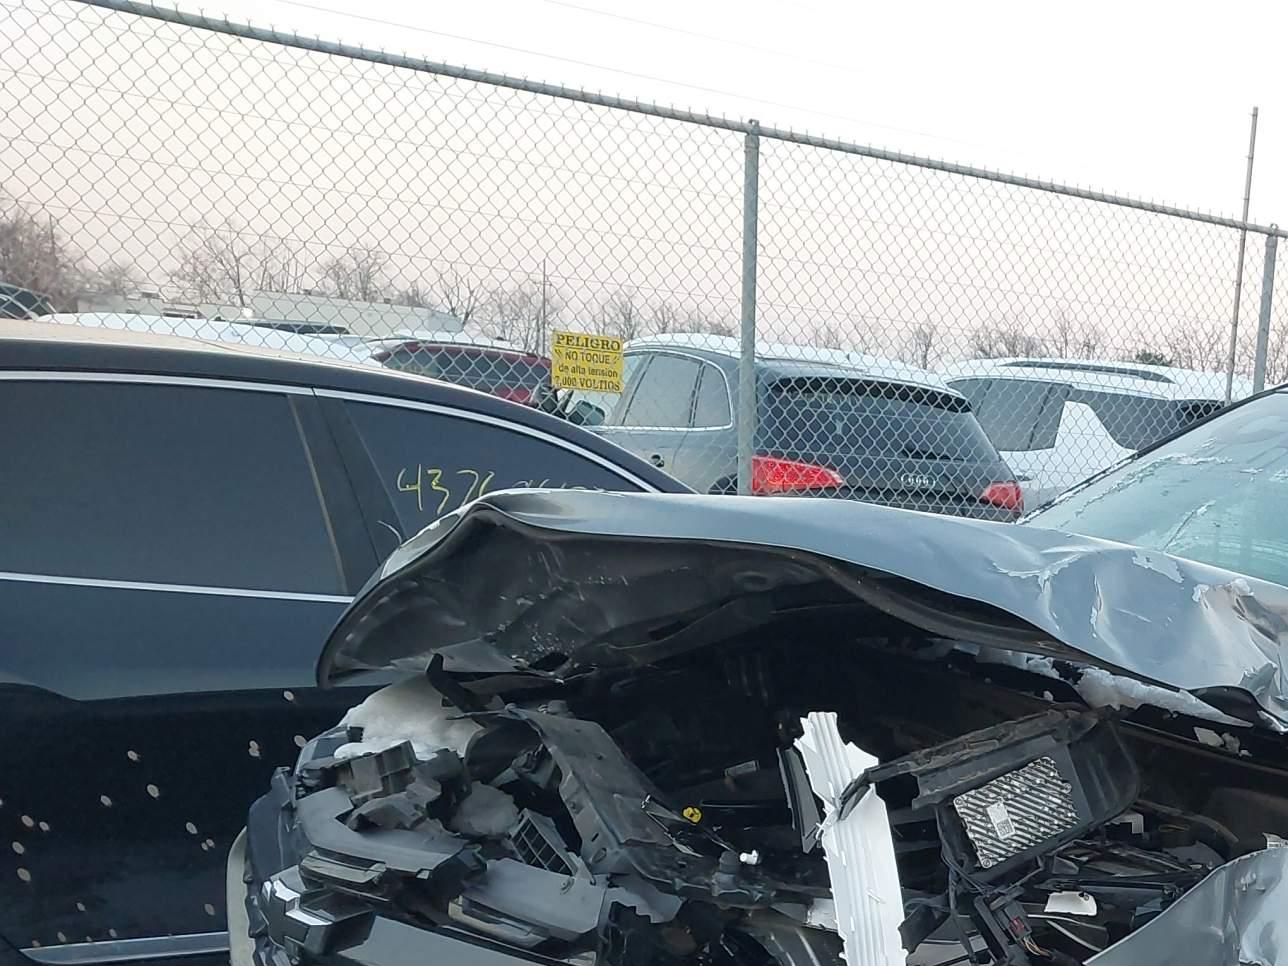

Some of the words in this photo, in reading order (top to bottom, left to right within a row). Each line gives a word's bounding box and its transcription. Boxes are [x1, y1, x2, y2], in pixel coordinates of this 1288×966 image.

[555, 333, 620, 351] PELIGRO
[565, 350, 578, 361] NO
[581, 352, 611, 365] TOQUE
[571, 364, 586, 375] alta
[555, 375, 577, 387] 7,000
[579, 378, 621, 391] VOLTIOS
